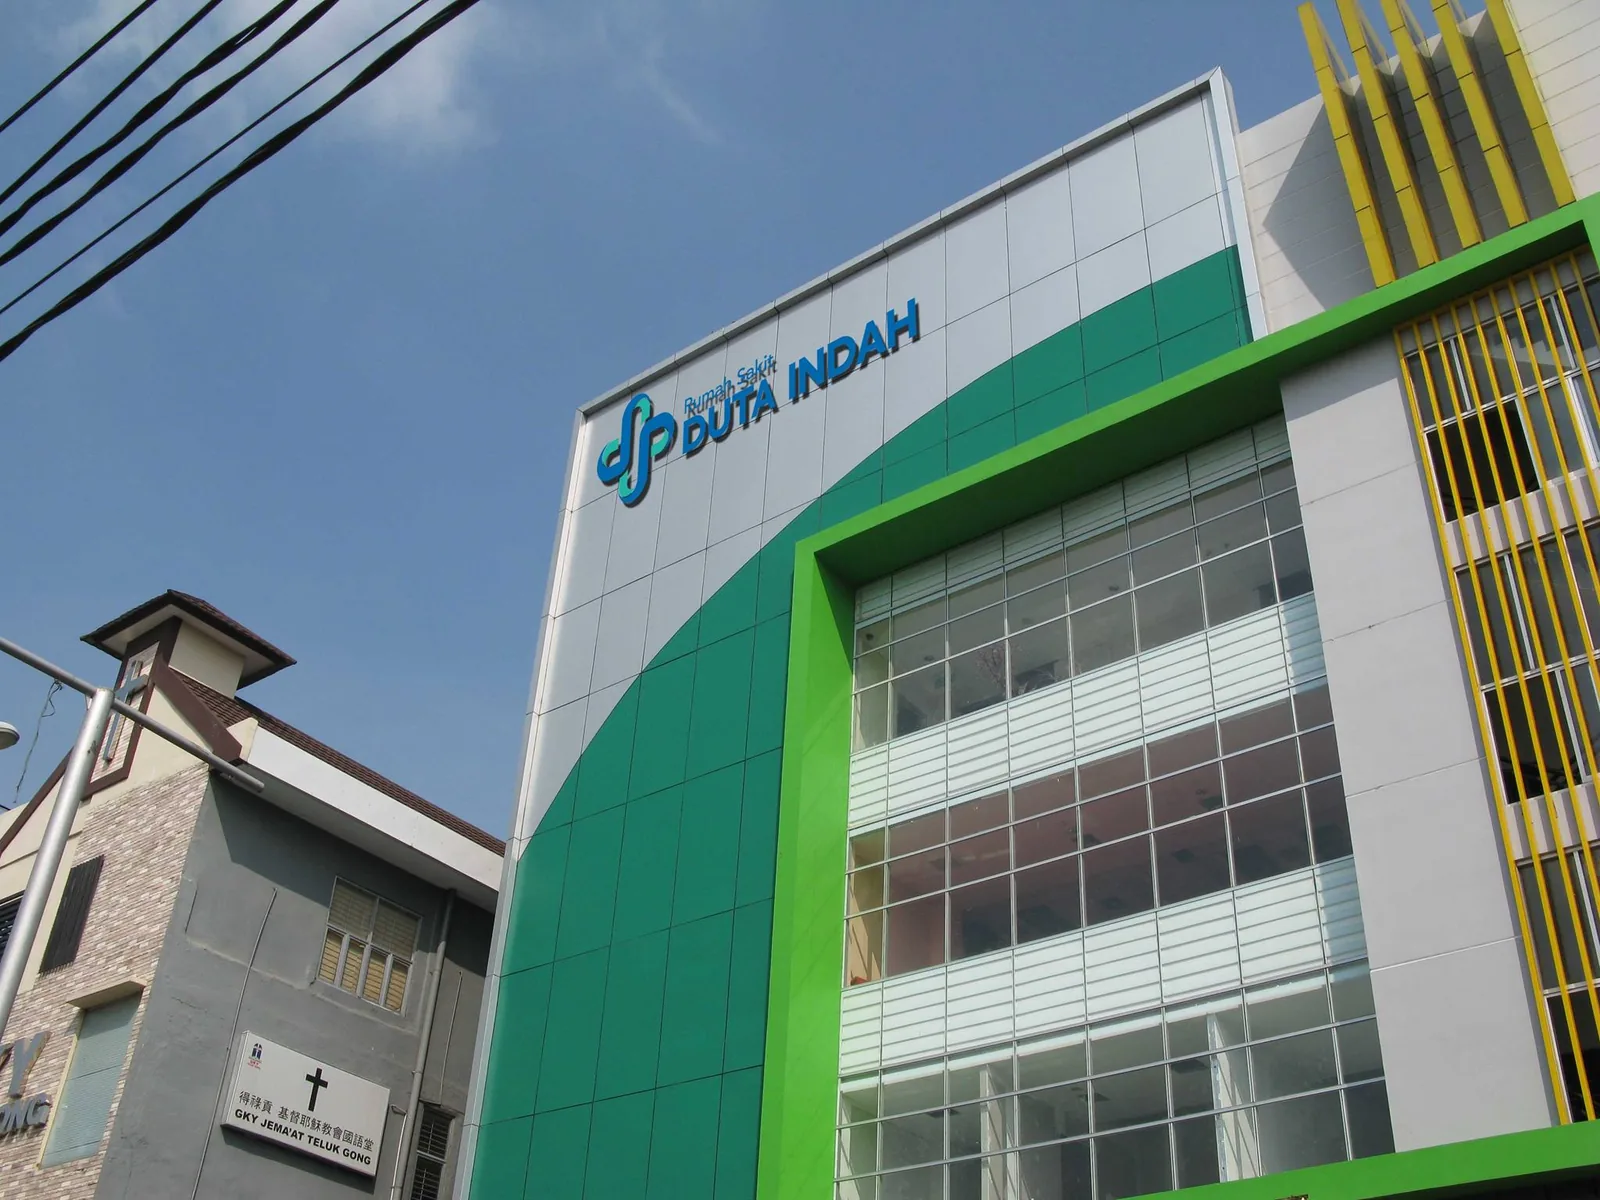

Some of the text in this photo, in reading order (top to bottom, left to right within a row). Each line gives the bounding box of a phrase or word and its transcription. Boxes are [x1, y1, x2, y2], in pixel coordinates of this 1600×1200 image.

[682, 297, 917, 455] DUTA INDAH
[684, 354, 774, 415] Rumah Sakit
[235, 1108, 371, 1165] GKY JEMA'AT TELUK GONG
